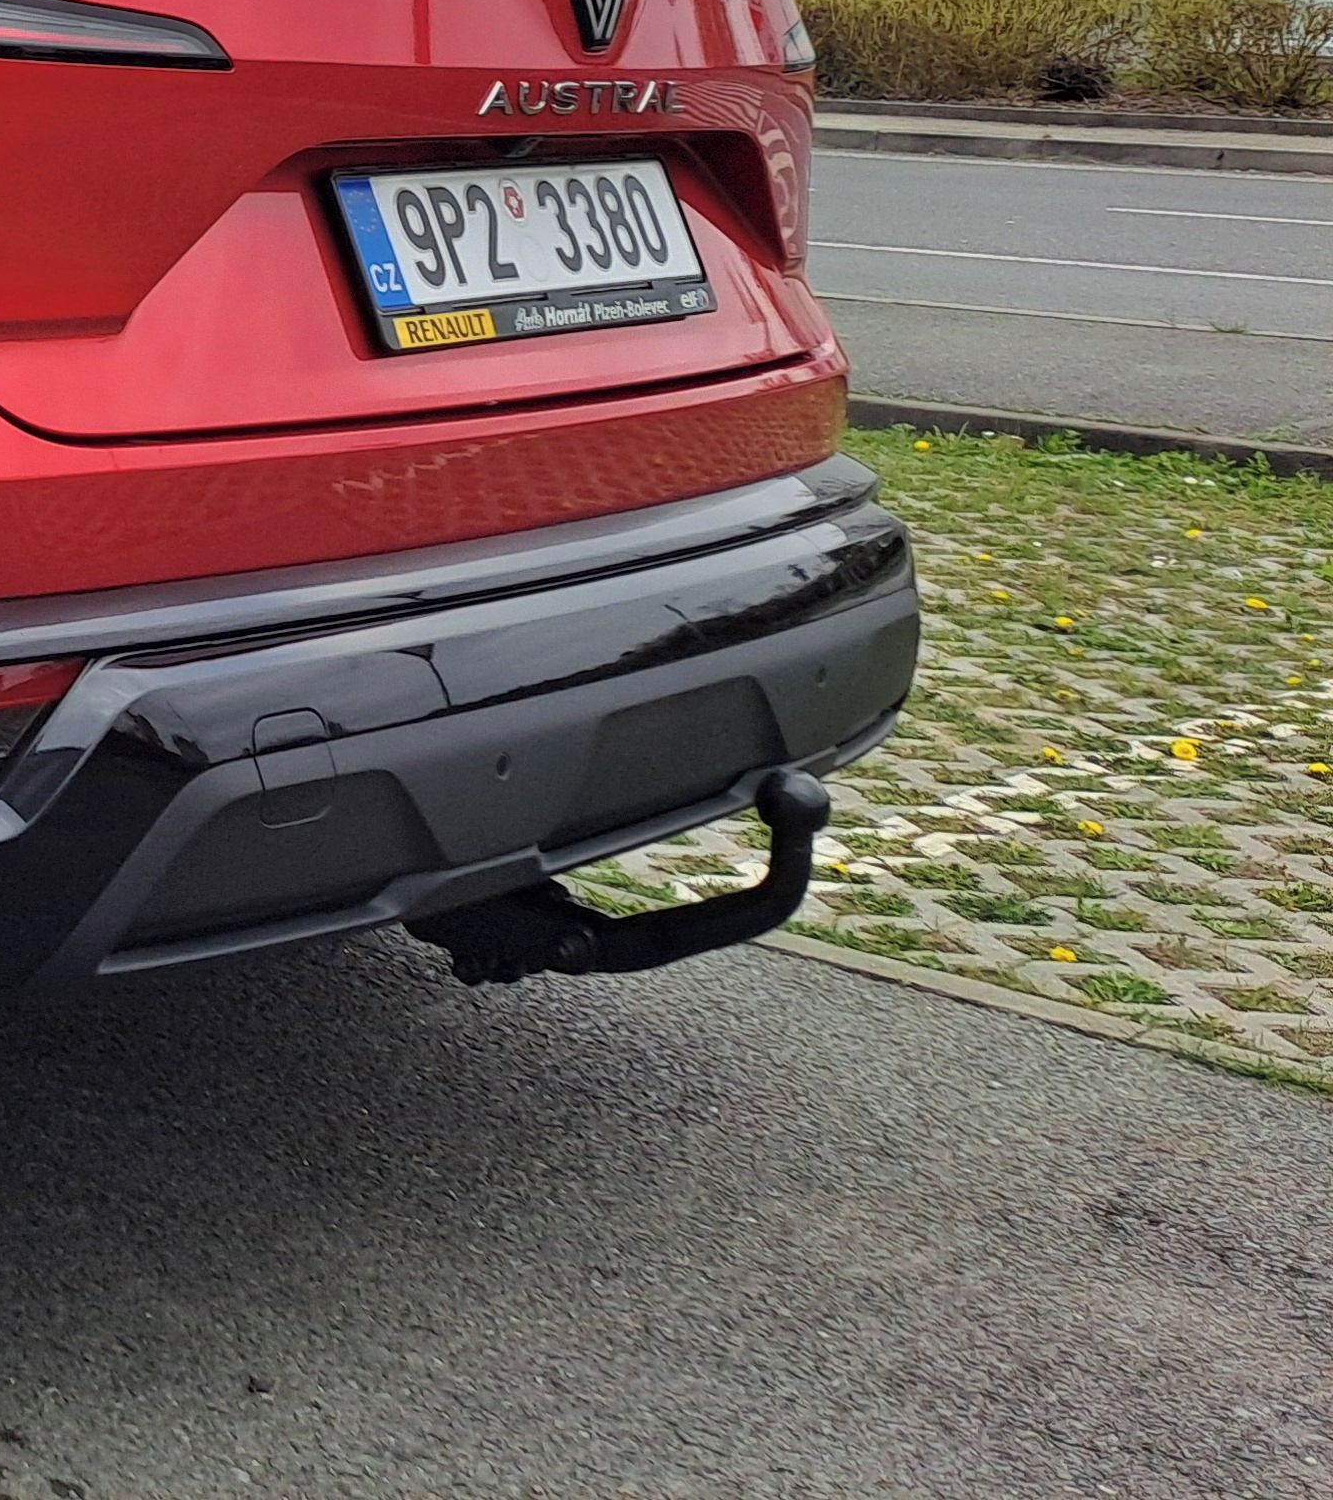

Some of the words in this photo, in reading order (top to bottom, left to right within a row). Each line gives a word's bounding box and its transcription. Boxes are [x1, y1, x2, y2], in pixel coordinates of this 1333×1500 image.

[477, 80, 686, 116] AUSTRAL
[396, 184, 520, 287] 9P2
[537, 175, 670, 274] 3380
[370, 263, 403, 293] CZ
[406, 312, 489, 344] RENAULT
